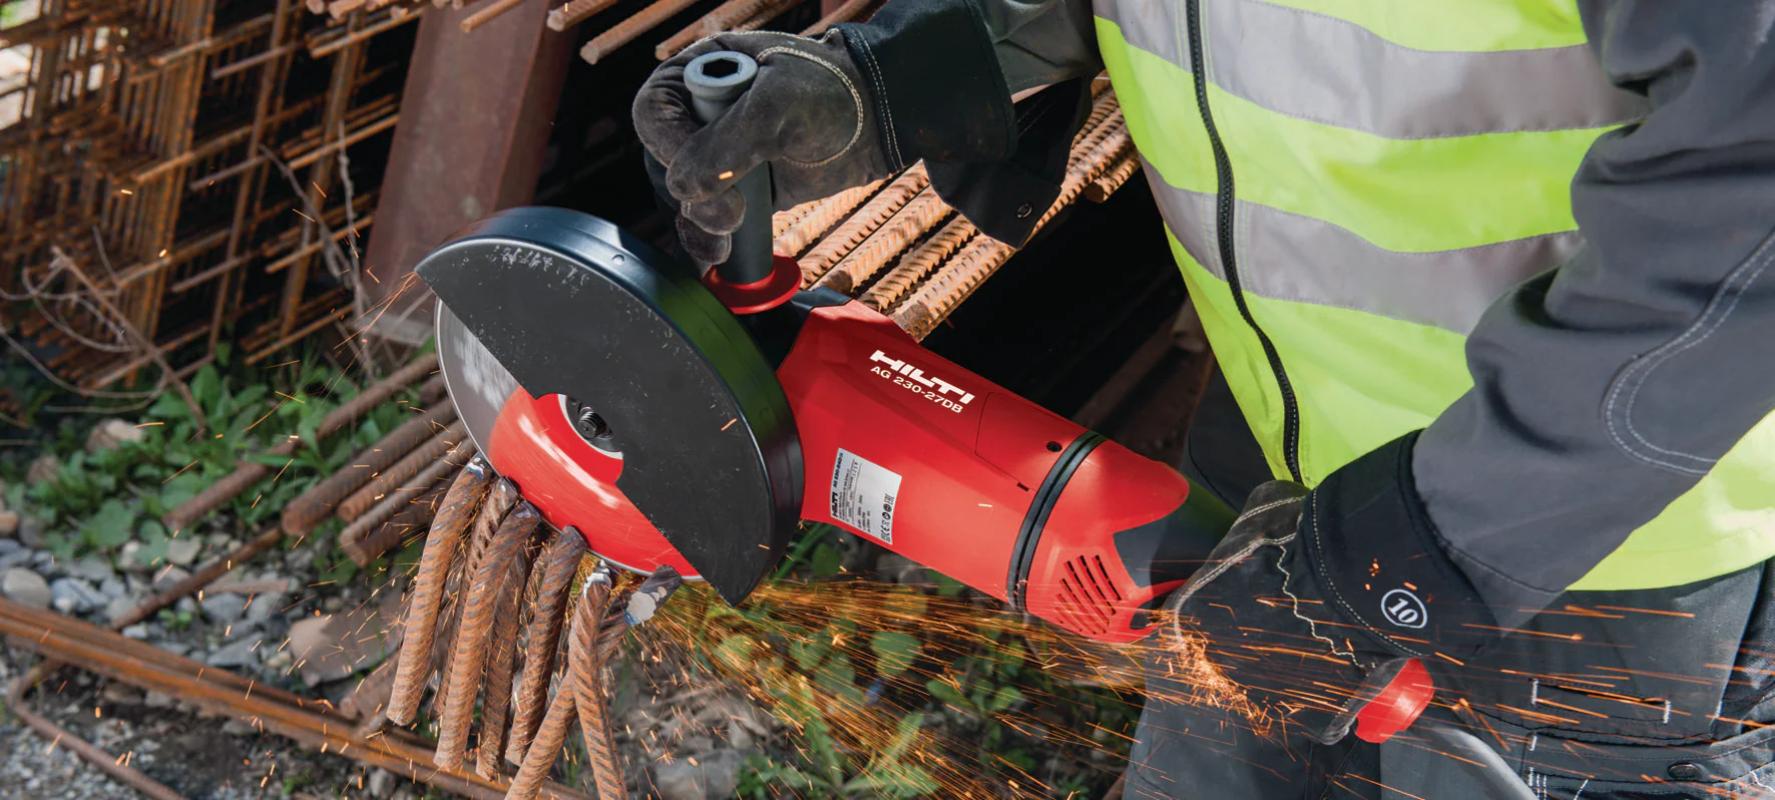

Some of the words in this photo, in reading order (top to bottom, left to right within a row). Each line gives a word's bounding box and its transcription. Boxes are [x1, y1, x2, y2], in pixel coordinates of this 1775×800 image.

[870, 350, 975, 404] HILTI
[870, 366, 892, 379] AG
[893, 376, 964, 413] 230-27DB
[1388, 598, 1418, 623] 10
